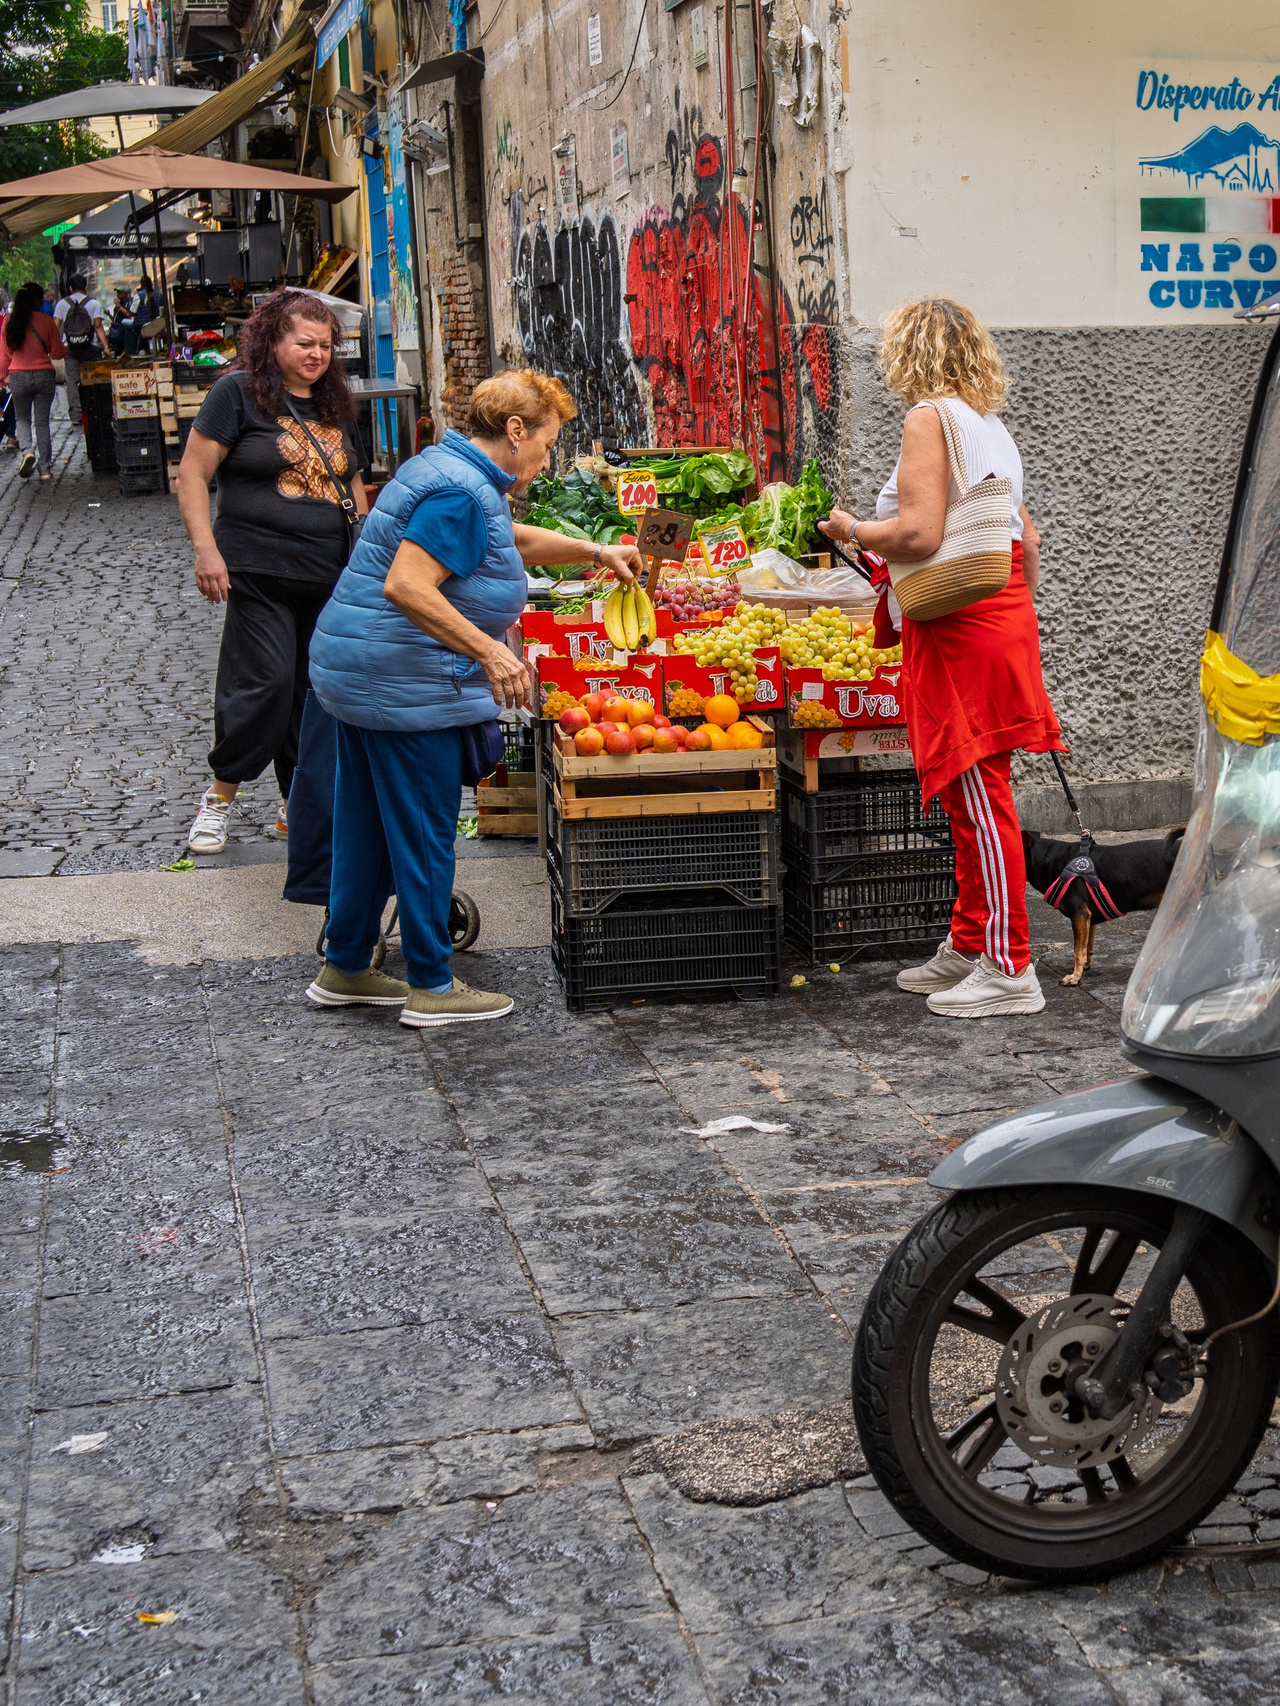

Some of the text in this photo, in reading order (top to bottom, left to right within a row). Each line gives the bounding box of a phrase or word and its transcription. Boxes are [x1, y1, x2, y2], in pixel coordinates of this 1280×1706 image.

[1136, 70, 1255, 122] Disperato
[108, 235, 150, 247] Cafftteia
[119, 380, 138, 389] safe
[621, 484, 656, 507] 1.00
[711, 539, 747, 569] 1,20
[834, 686, 900, 719] Uva
[1145, 1176, 1176, 1189] SBC
